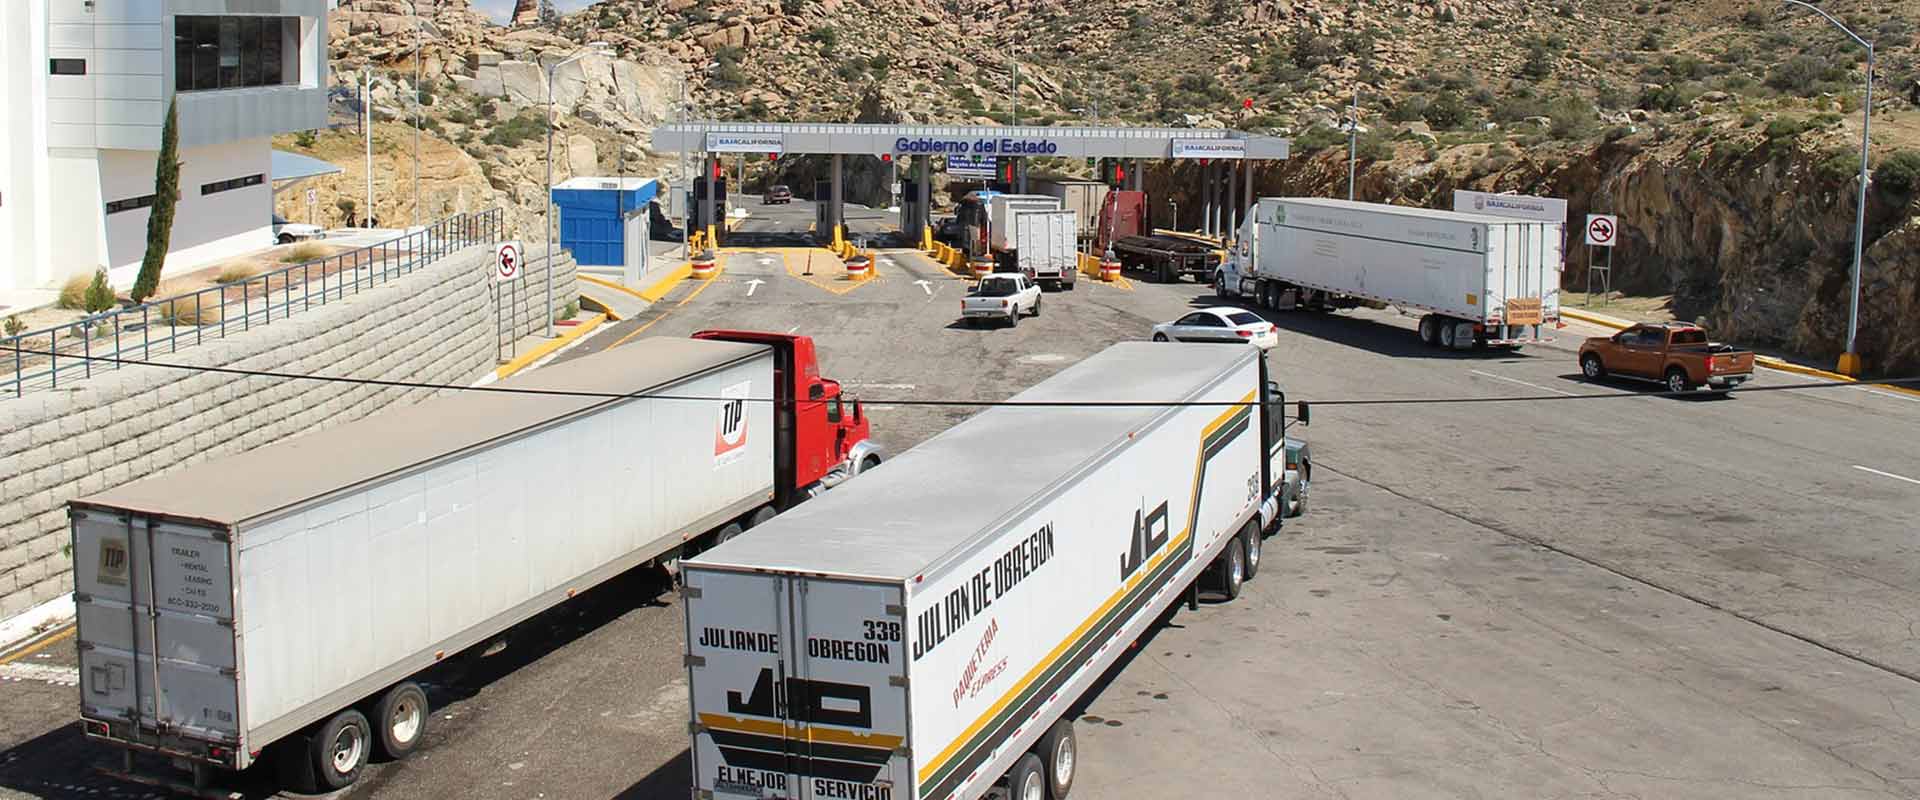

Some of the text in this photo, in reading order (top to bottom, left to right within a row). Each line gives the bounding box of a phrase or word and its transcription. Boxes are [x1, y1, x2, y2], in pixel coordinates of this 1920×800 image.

[896, 137, 1057, 154] Gobierno del Estado
[723, 399, 743, 436] TIP
[912, 520, 1055, 662] JULIAN DE OBREGON
[863, 620, 901, 642] 338
[808, 637, 890, 664] OBREGON
[952, 617, 999, 709] PAQUETERIA
